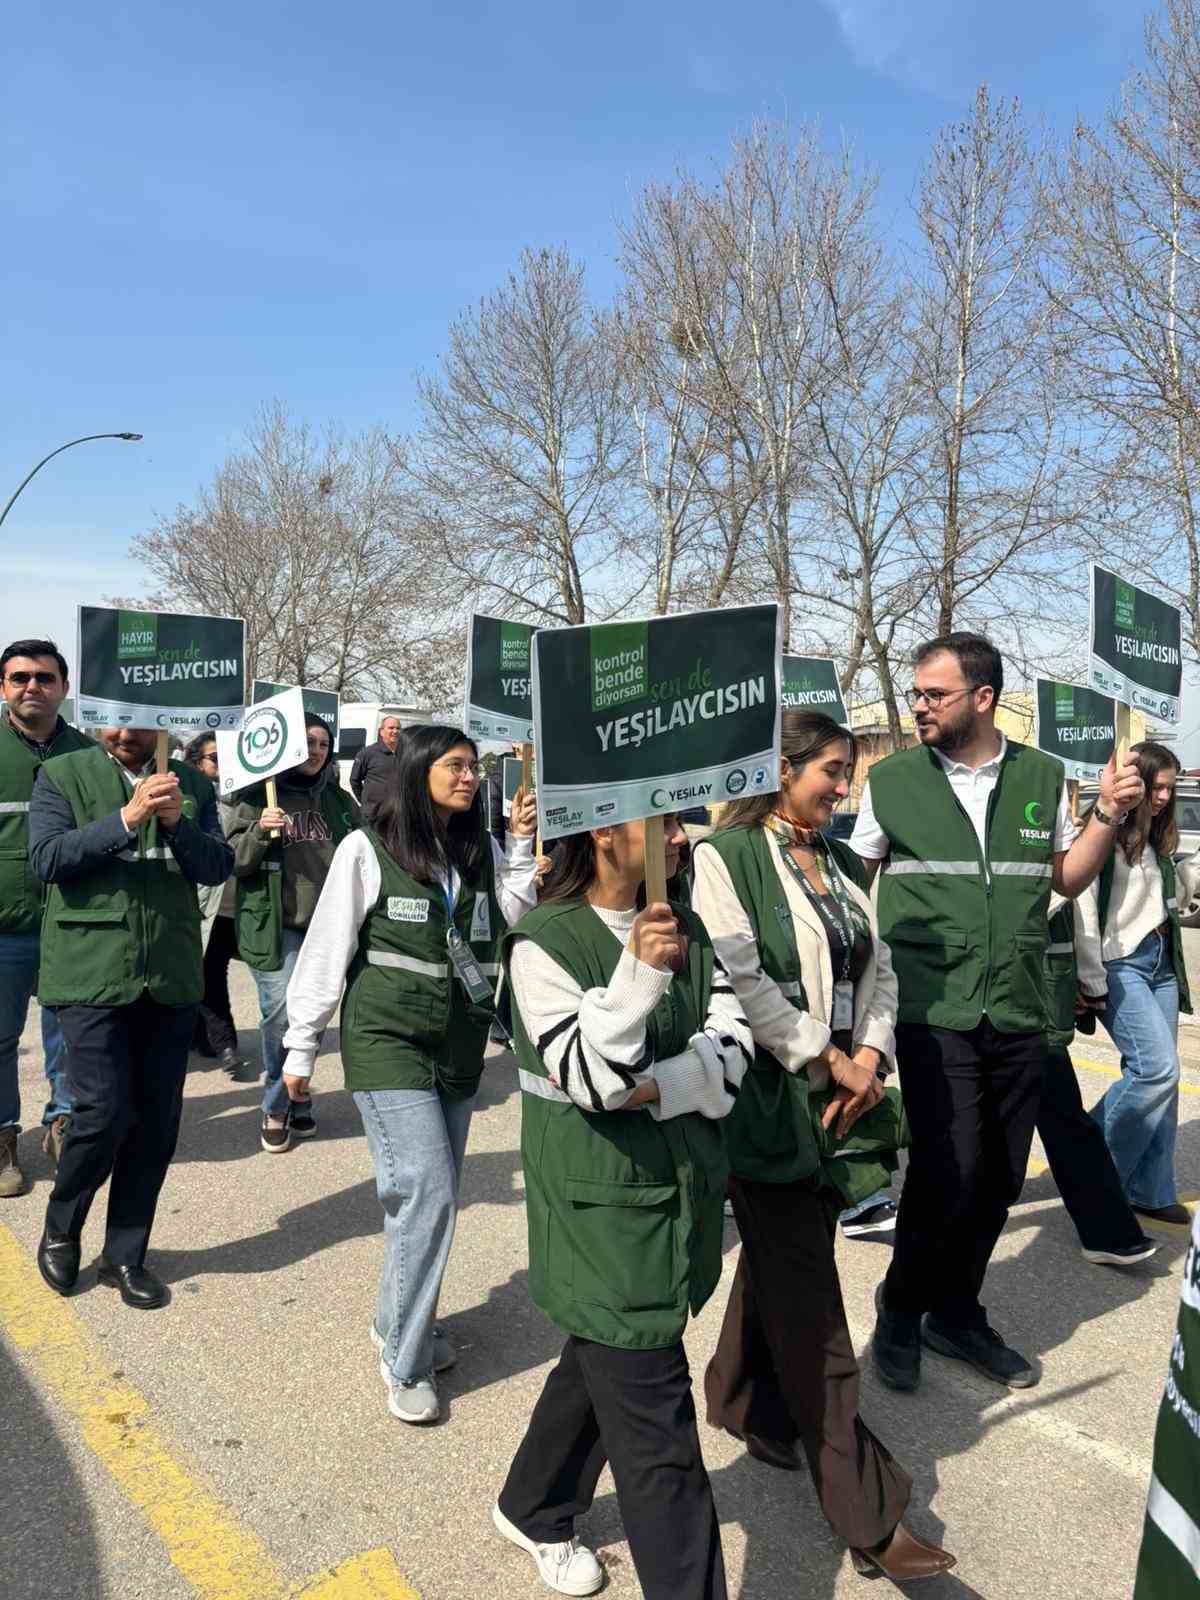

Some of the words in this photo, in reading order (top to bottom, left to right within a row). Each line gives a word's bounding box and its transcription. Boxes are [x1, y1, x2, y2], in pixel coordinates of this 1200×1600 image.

[121, 631, 154, 645] HAYIR
[595, 644, 644, 674] kontrol
[595, 664, 644, 692] bende
[688, 657, 712, 690] de
[595, 683, 644, 706] diyorsan
